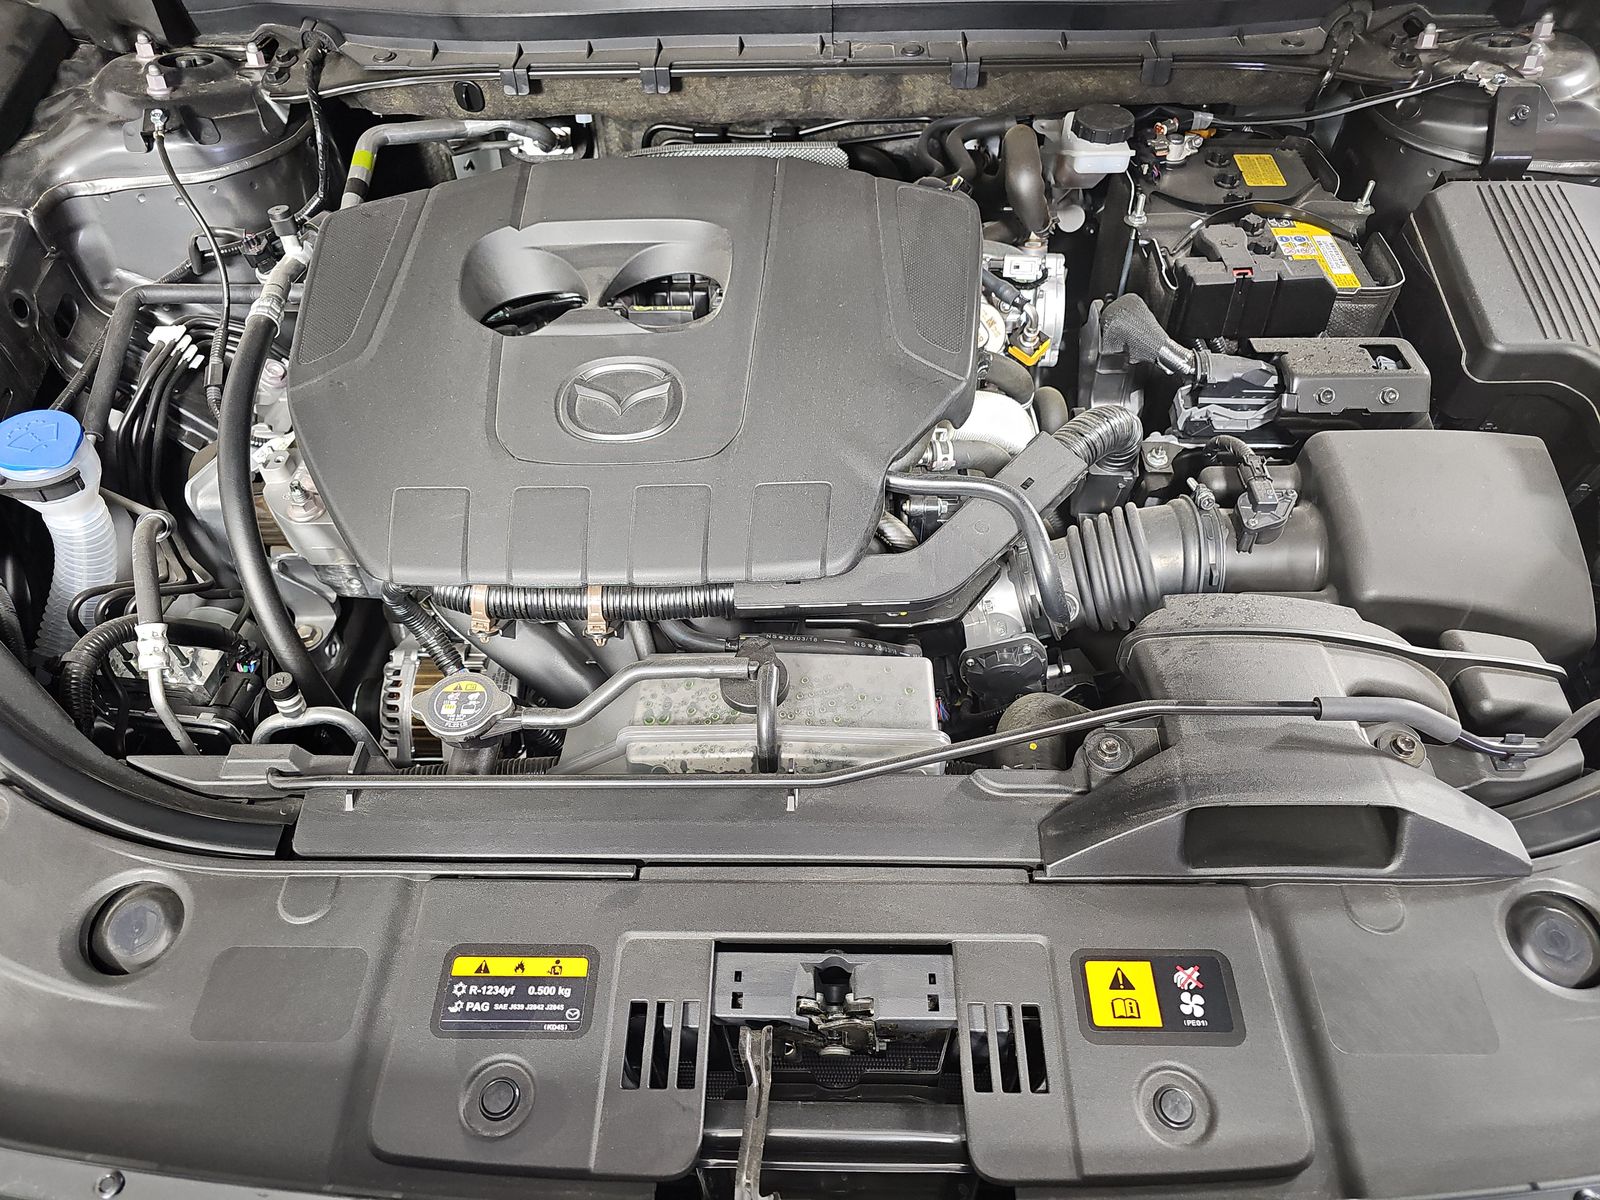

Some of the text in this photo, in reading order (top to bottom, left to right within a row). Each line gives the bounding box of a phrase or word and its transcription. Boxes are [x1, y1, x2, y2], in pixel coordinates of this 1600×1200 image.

[469, 985, 572, 998] R-1234yf 0.500 kg
[465, 1001, 490, 1012] PAG
